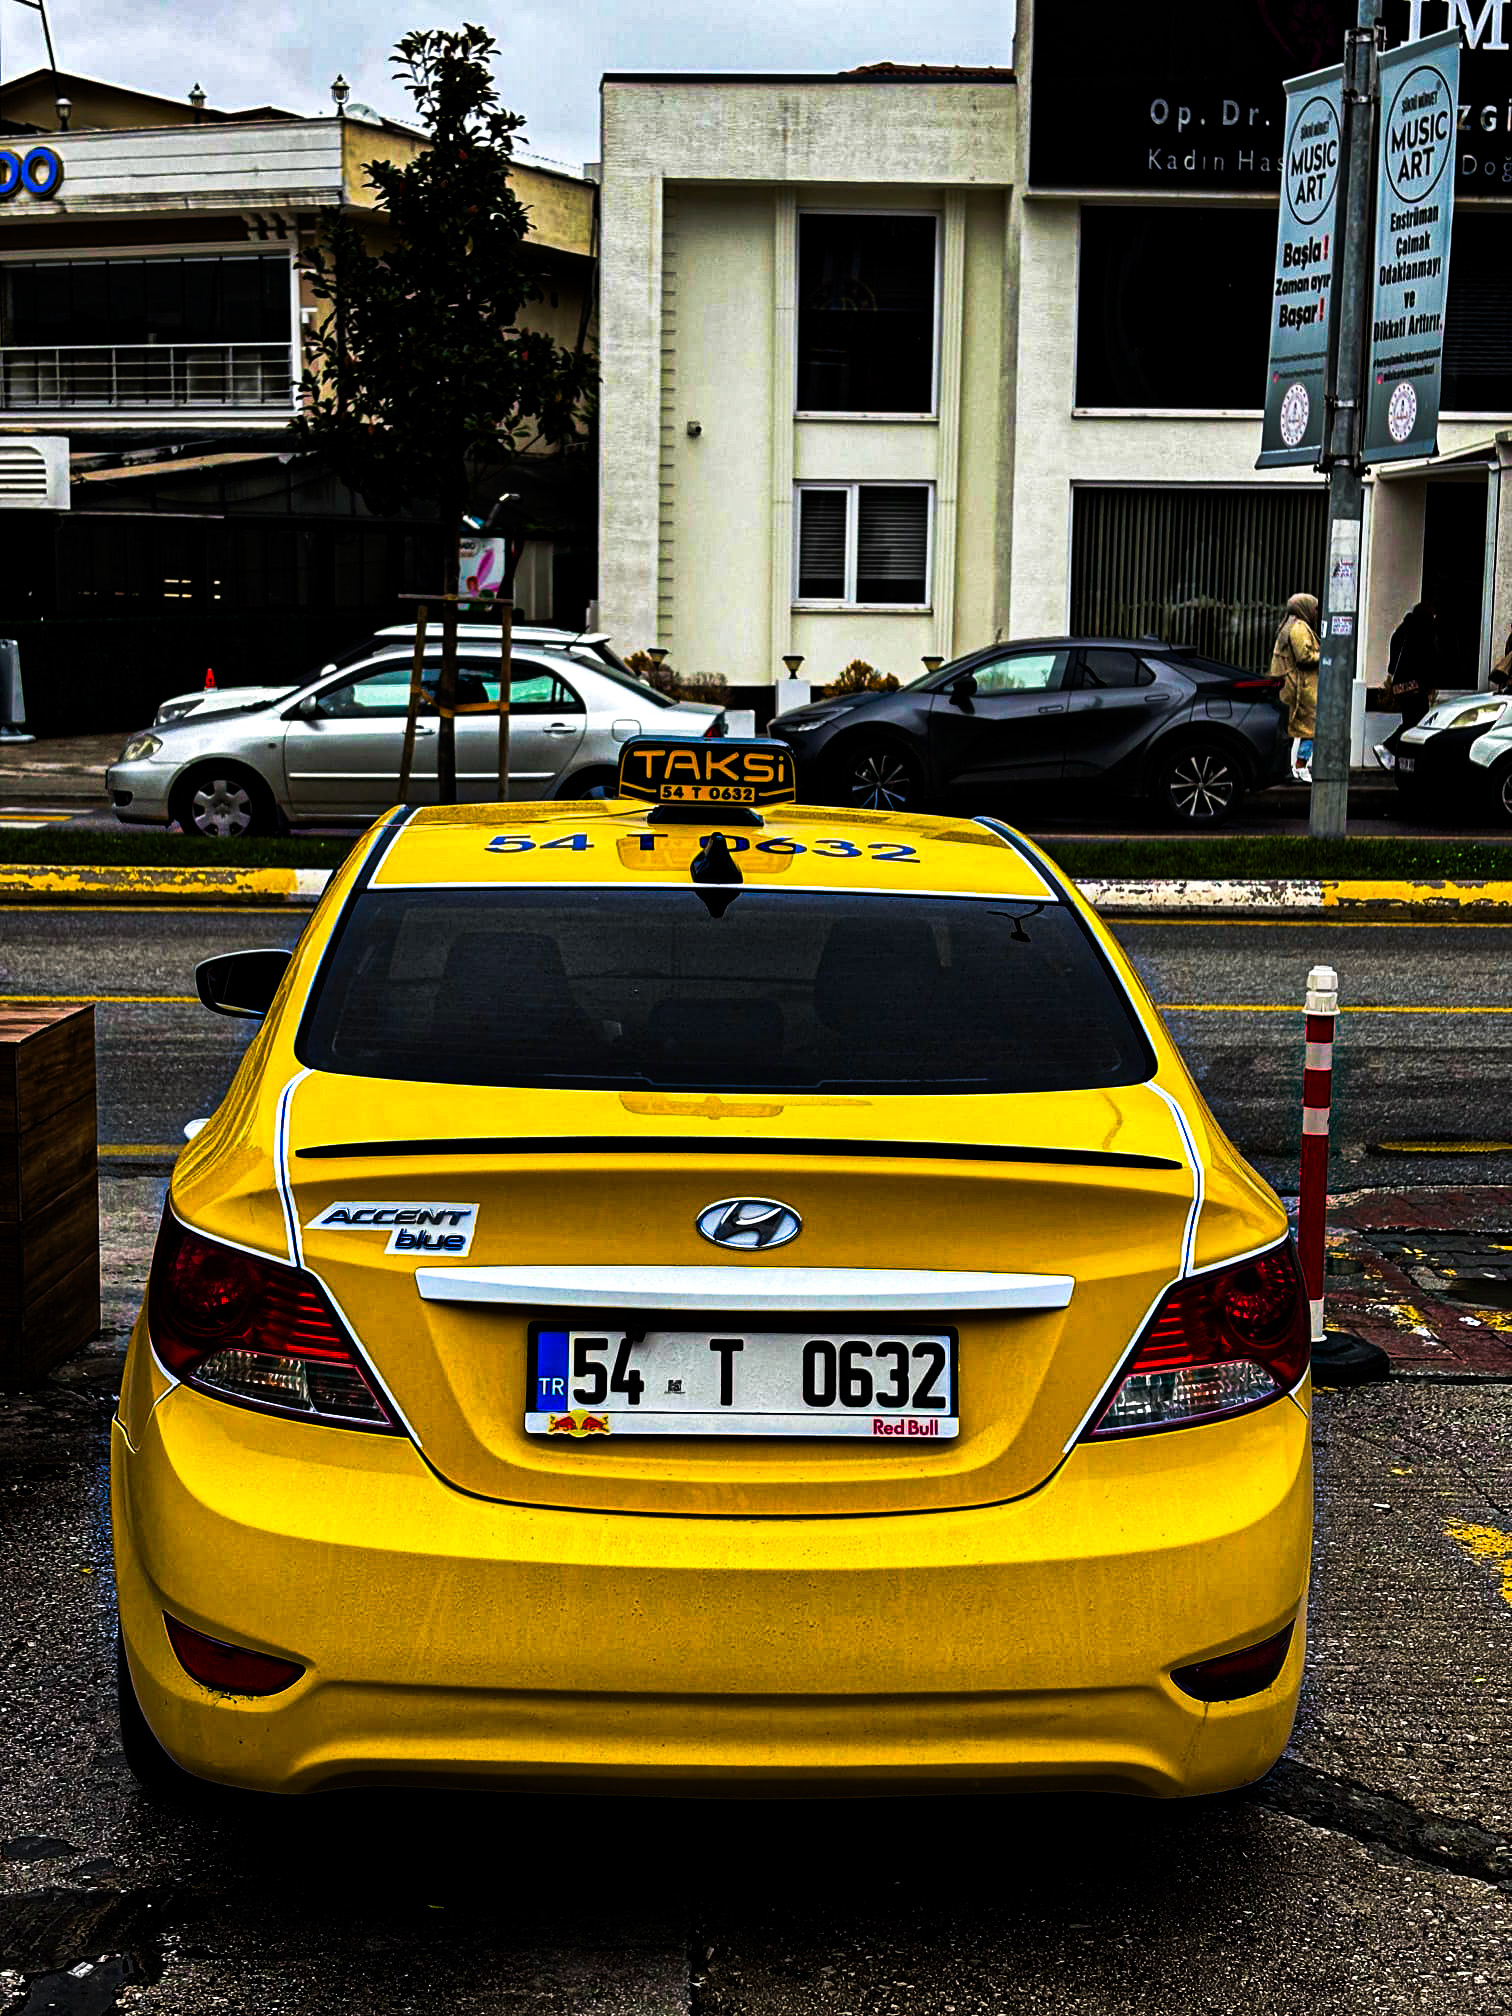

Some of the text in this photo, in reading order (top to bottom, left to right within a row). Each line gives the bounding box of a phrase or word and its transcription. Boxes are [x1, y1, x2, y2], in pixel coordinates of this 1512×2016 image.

[1150, 98, 1206, 133] Op.
[1222, 99, 1270, 126] Dr.
[1391, 111, 1448, 154] MUSIC
[1148, 148, 1225, 171] Kadın
[1291, 140, 1337, 176] MUSIC
[1397, 147, 1435, 183] ART
[1295, 173, 1326, 205] ART
[1390, 206, 1439, 232] Enstrüman
[1396, 231, 1430, 259] Çalmak
[1379, 257, 1441, 286] Odaklanmayı
[1275, 274, 1331, 296] Zaman ayır
[1404, 291, 1415, 309] ve
[1373, 317, 1406, 342] Dikkati
[662, 786, 753, 800] 54 T 0632
[484, 833, 921, 863] 54 T 0632
[321, 1208, 471, 1226] ACCENT
[395, 1228, 466, 1250] blue
[572, 1337, 947, 1409] 54 T 0632
[538, 1378, 565, 1396] TR
[872, 1418, 939, 1436] Red Bull
